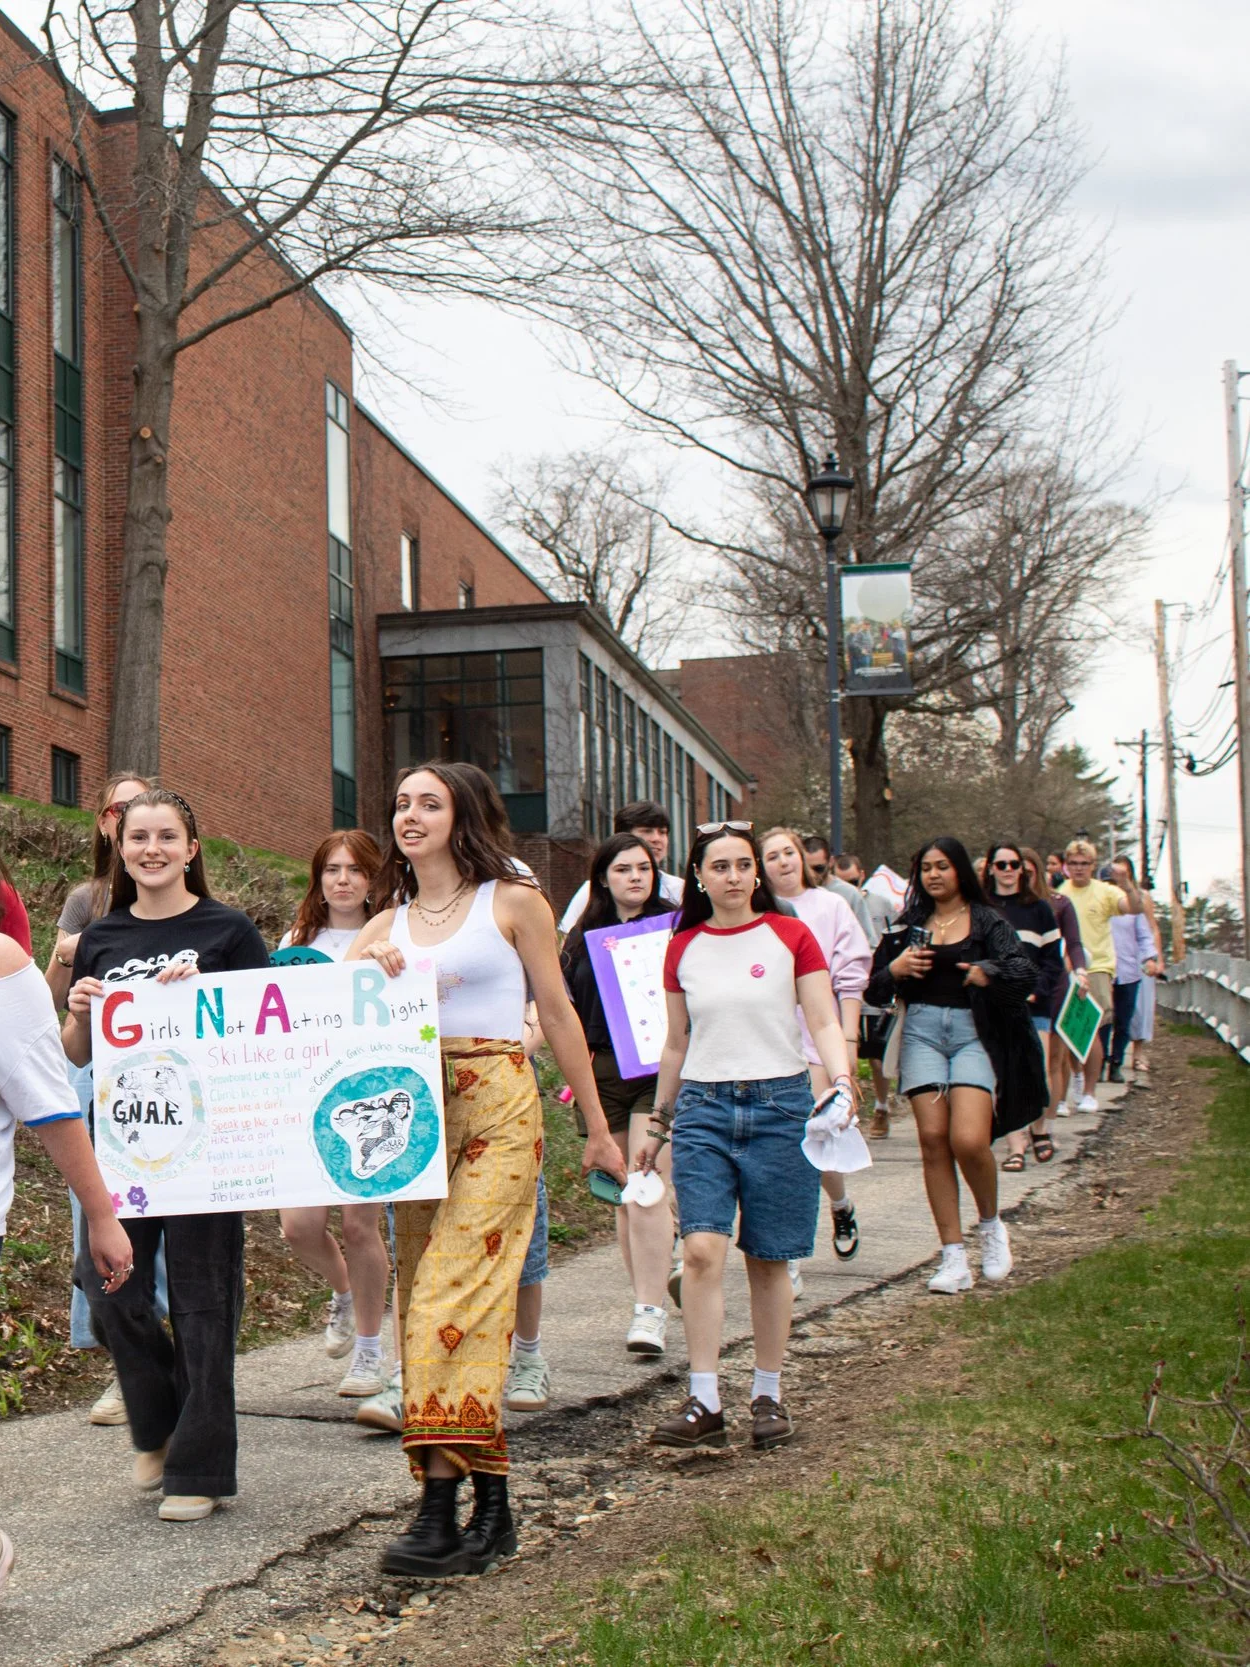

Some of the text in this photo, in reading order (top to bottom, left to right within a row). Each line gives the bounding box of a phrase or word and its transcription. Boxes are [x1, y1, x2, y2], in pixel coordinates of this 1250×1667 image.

[102, 968, 429, 1048] Girls Not Acting Right
[207, 1039, 329, 1070] Ski Like a girl
